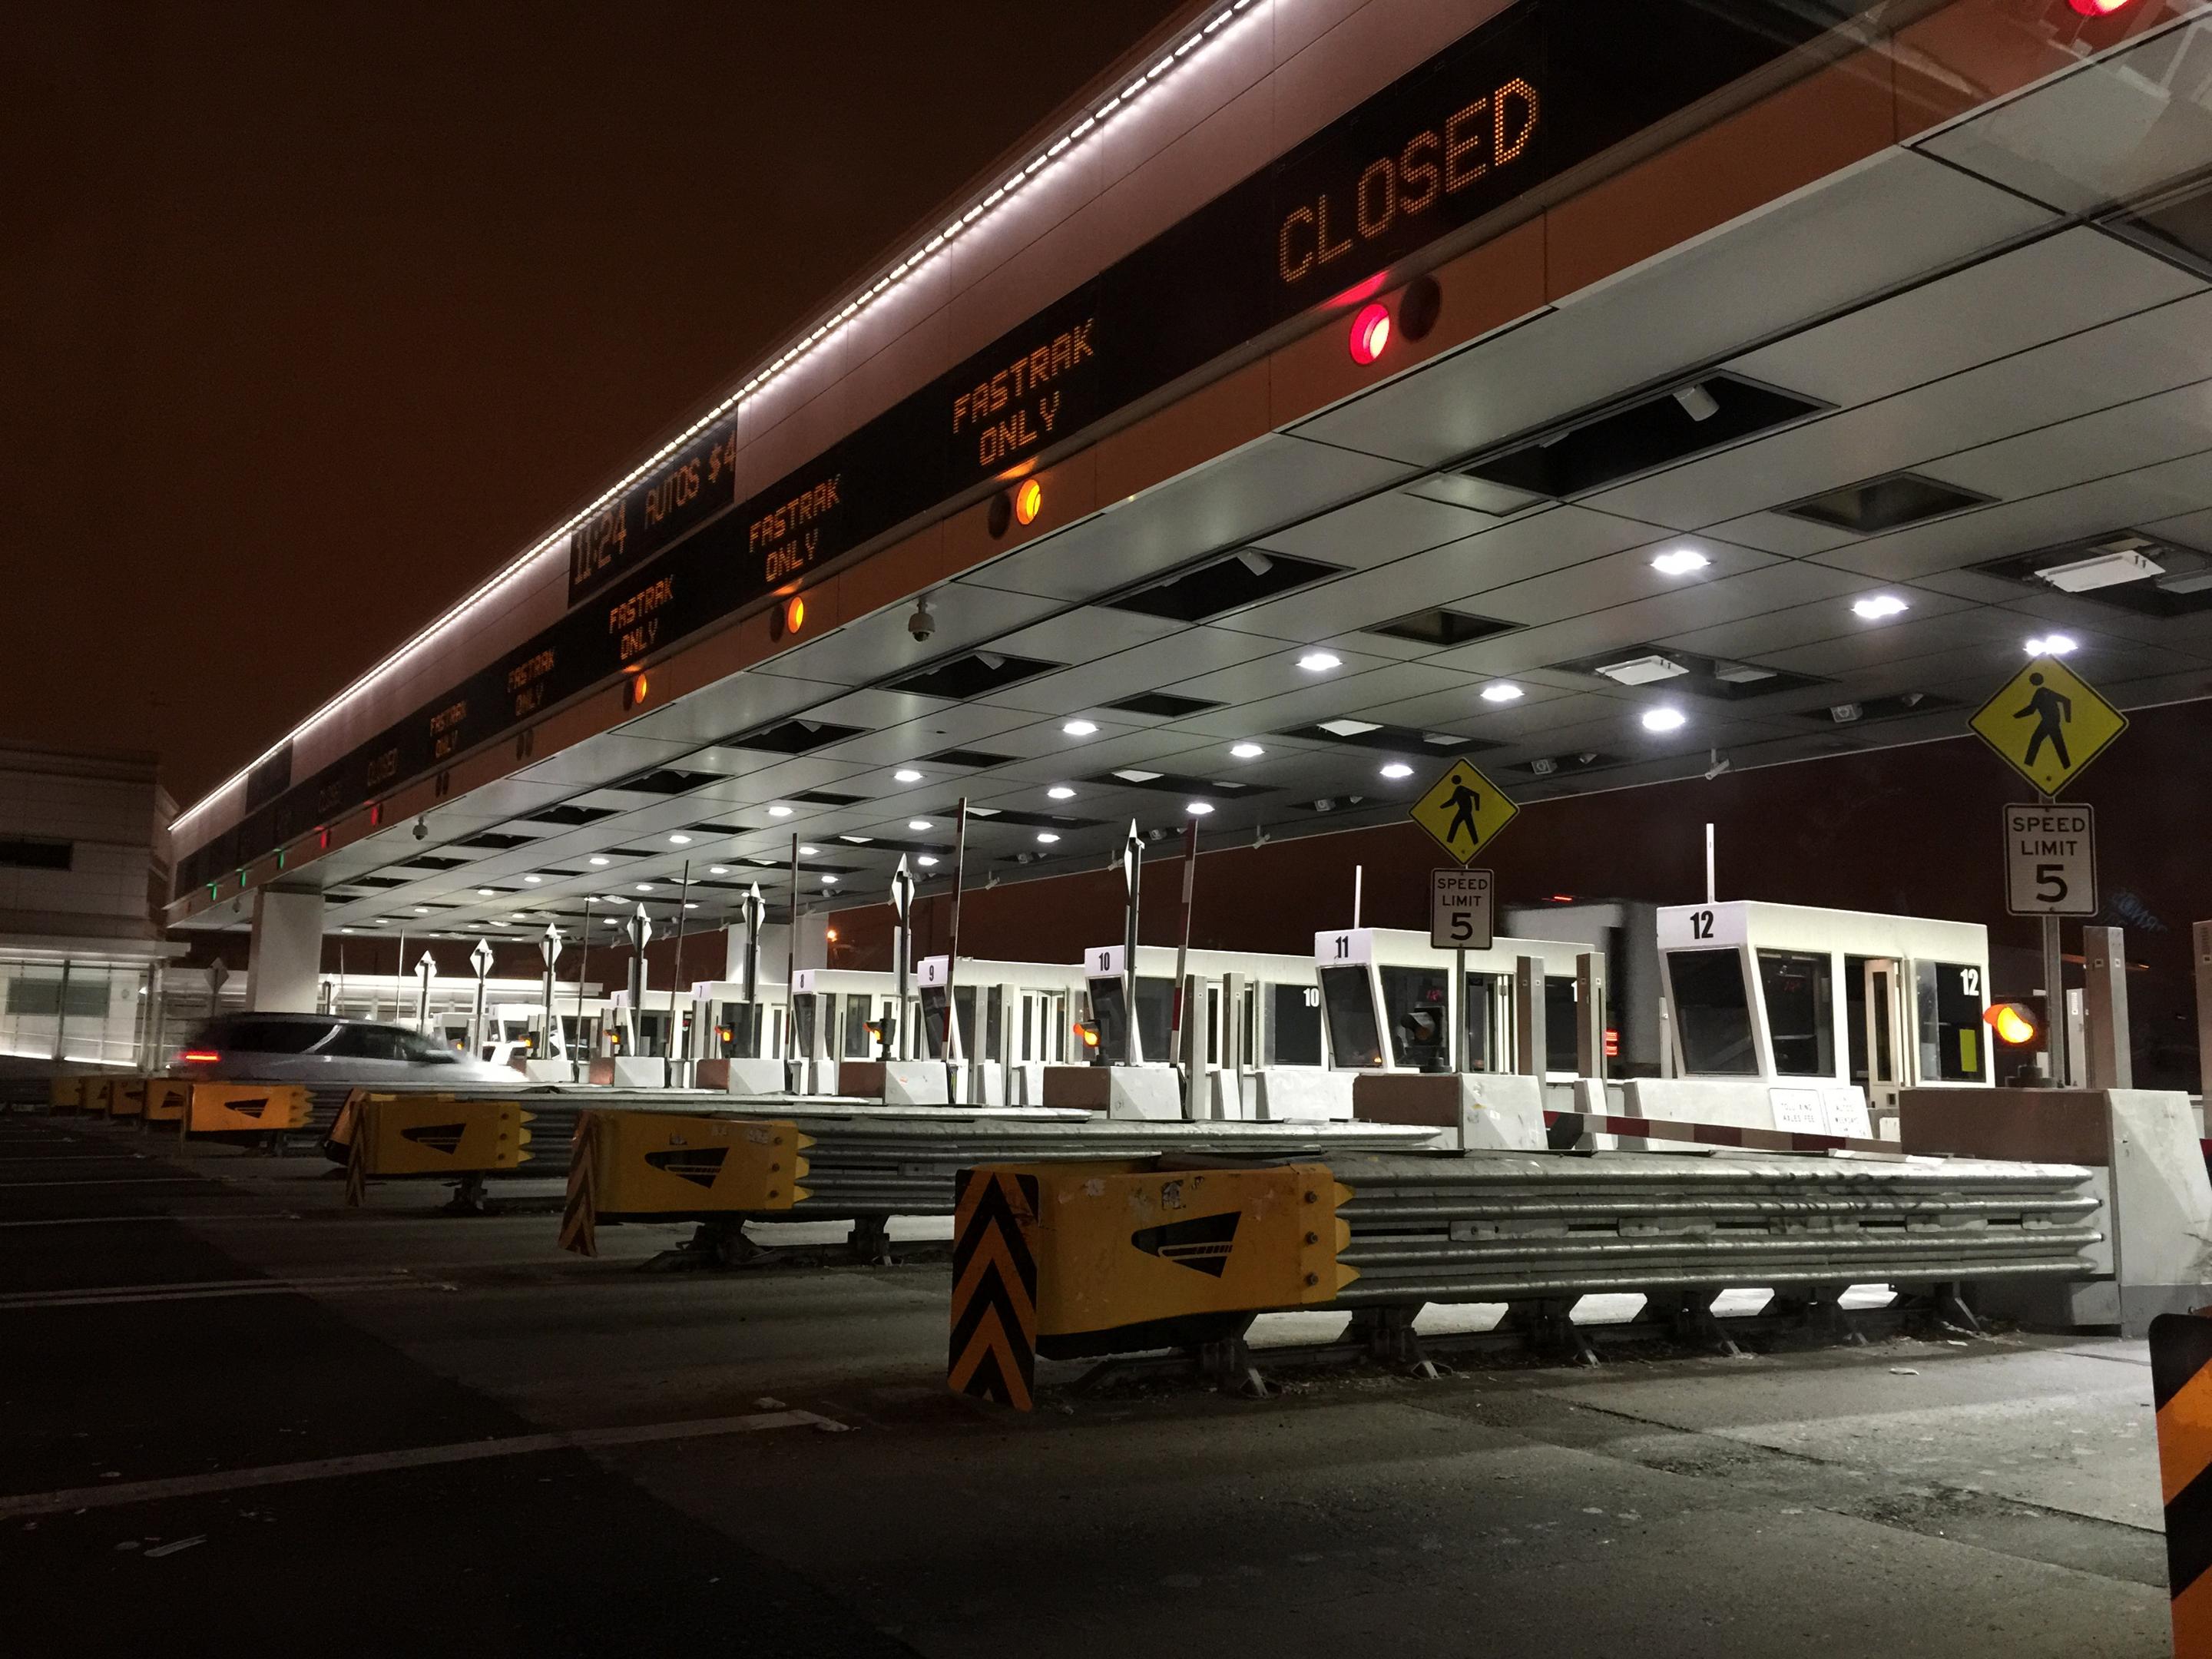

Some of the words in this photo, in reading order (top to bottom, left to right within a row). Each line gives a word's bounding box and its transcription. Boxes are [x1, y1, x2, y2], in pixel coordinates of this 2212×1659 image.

[1278, 77, 1539, 282] CLOSED
[952, 317, 1094, 434] FASTRAK
[979, 390, 1060, 466] ONLY
[644, 457, 700, 530] AUTOS
[750, 473, 841, 553] FASTRAK
[766, 528, 819, 582] ONLY
[609, 574, 674, 634] FASTRAK
[621, 618, 658, 661] ONLY
[2012, 816, 2085, 833] SPEED
[2021, 840, 2078, 856] LIMIT
[1437, 878, 1488, 890] SPEED
[2036, 864, 2068, 903] 5
[1442, 895, 1482, 906] LIMIT
[1450, 912, 1473, 941] 5
[1690, 910, 1714, 939] 12
[1098, 952, 1111, 971] 10
[1335, 935, 1349, 959] 11
[929, 965, 935, 982] 9
[1960, 969, 1979, 996] 12
[1303, 988, 1320, 1007] 10
